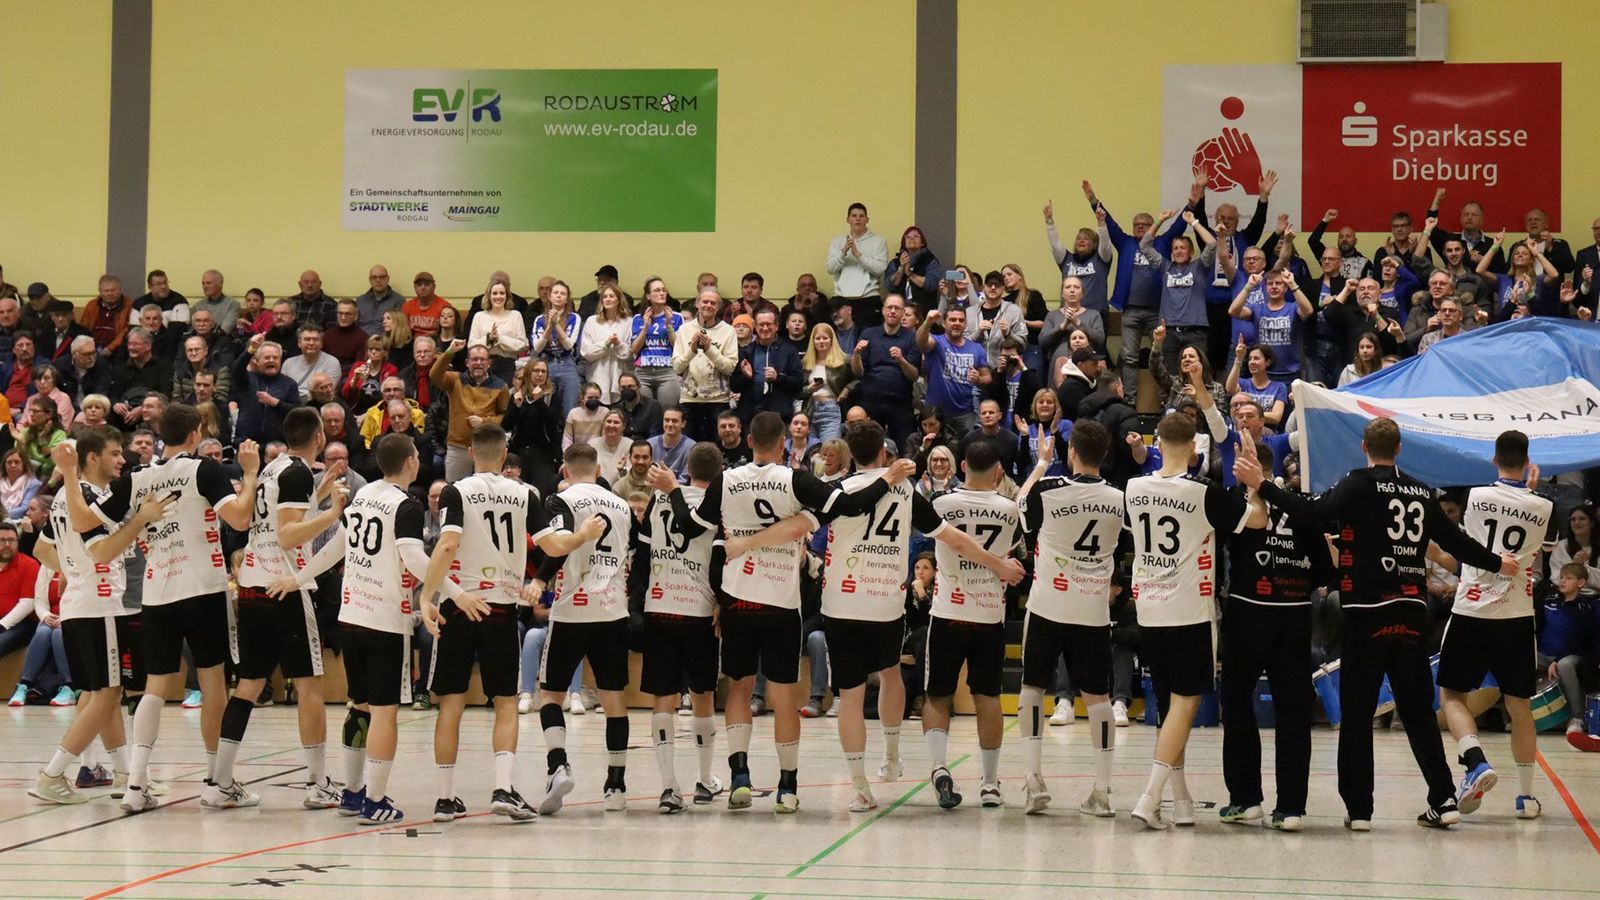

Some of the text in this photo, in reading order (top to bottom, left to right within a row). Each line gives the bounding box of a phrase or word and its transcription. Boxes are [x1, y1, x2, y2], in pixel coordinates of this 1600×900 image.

[371, 128, 502, 137] ENERGIEVERSORGUNG RODAU
[544, 121, 698, 137] www.ev-rodau.de
[1392, 124, 1528, 152] Sparkasse
[1392, 158, 1499, 186] Dieburg
[350, 189, 363, 197] Ein
[366, 188, 483, 197] Gemeinschaftsunternehmen
[350, 202, 429, 212] STADTWERKE
[448, 206, 500, 215] MAINGAU
[397, 214, 429, 222] RODGAU
[653, 323, 660, 334] 2
[1422, 412, 1495, 422] HSG
[1377, 481, 1395, 493] HSG
[572, 498, 592, 513] HSG
[1051, 504, 1123, 519] HSG HANAU
[1129, 496, 1197, 514] HSG HANAU
[753, 498, 781, 528] 9
[942, 509, 1017, 526] HSG HANAU
[1387, 498, 1425, 543] 33
[1471, 502, 1546, 527] HSG HANAU
[349, 512, 384, 556] 30
[484, 510, 514, 554] 11
[595, 512, 613, 553] 2
[1073, 519, 1100, 556] 4
[1138, 512, 1180, 556] 13
[850, 543, 901, 556] SCHRÖDER
[1392, 546, 1417, 556] TOMM
[1142, 554, 1180, 568] BRAUN
